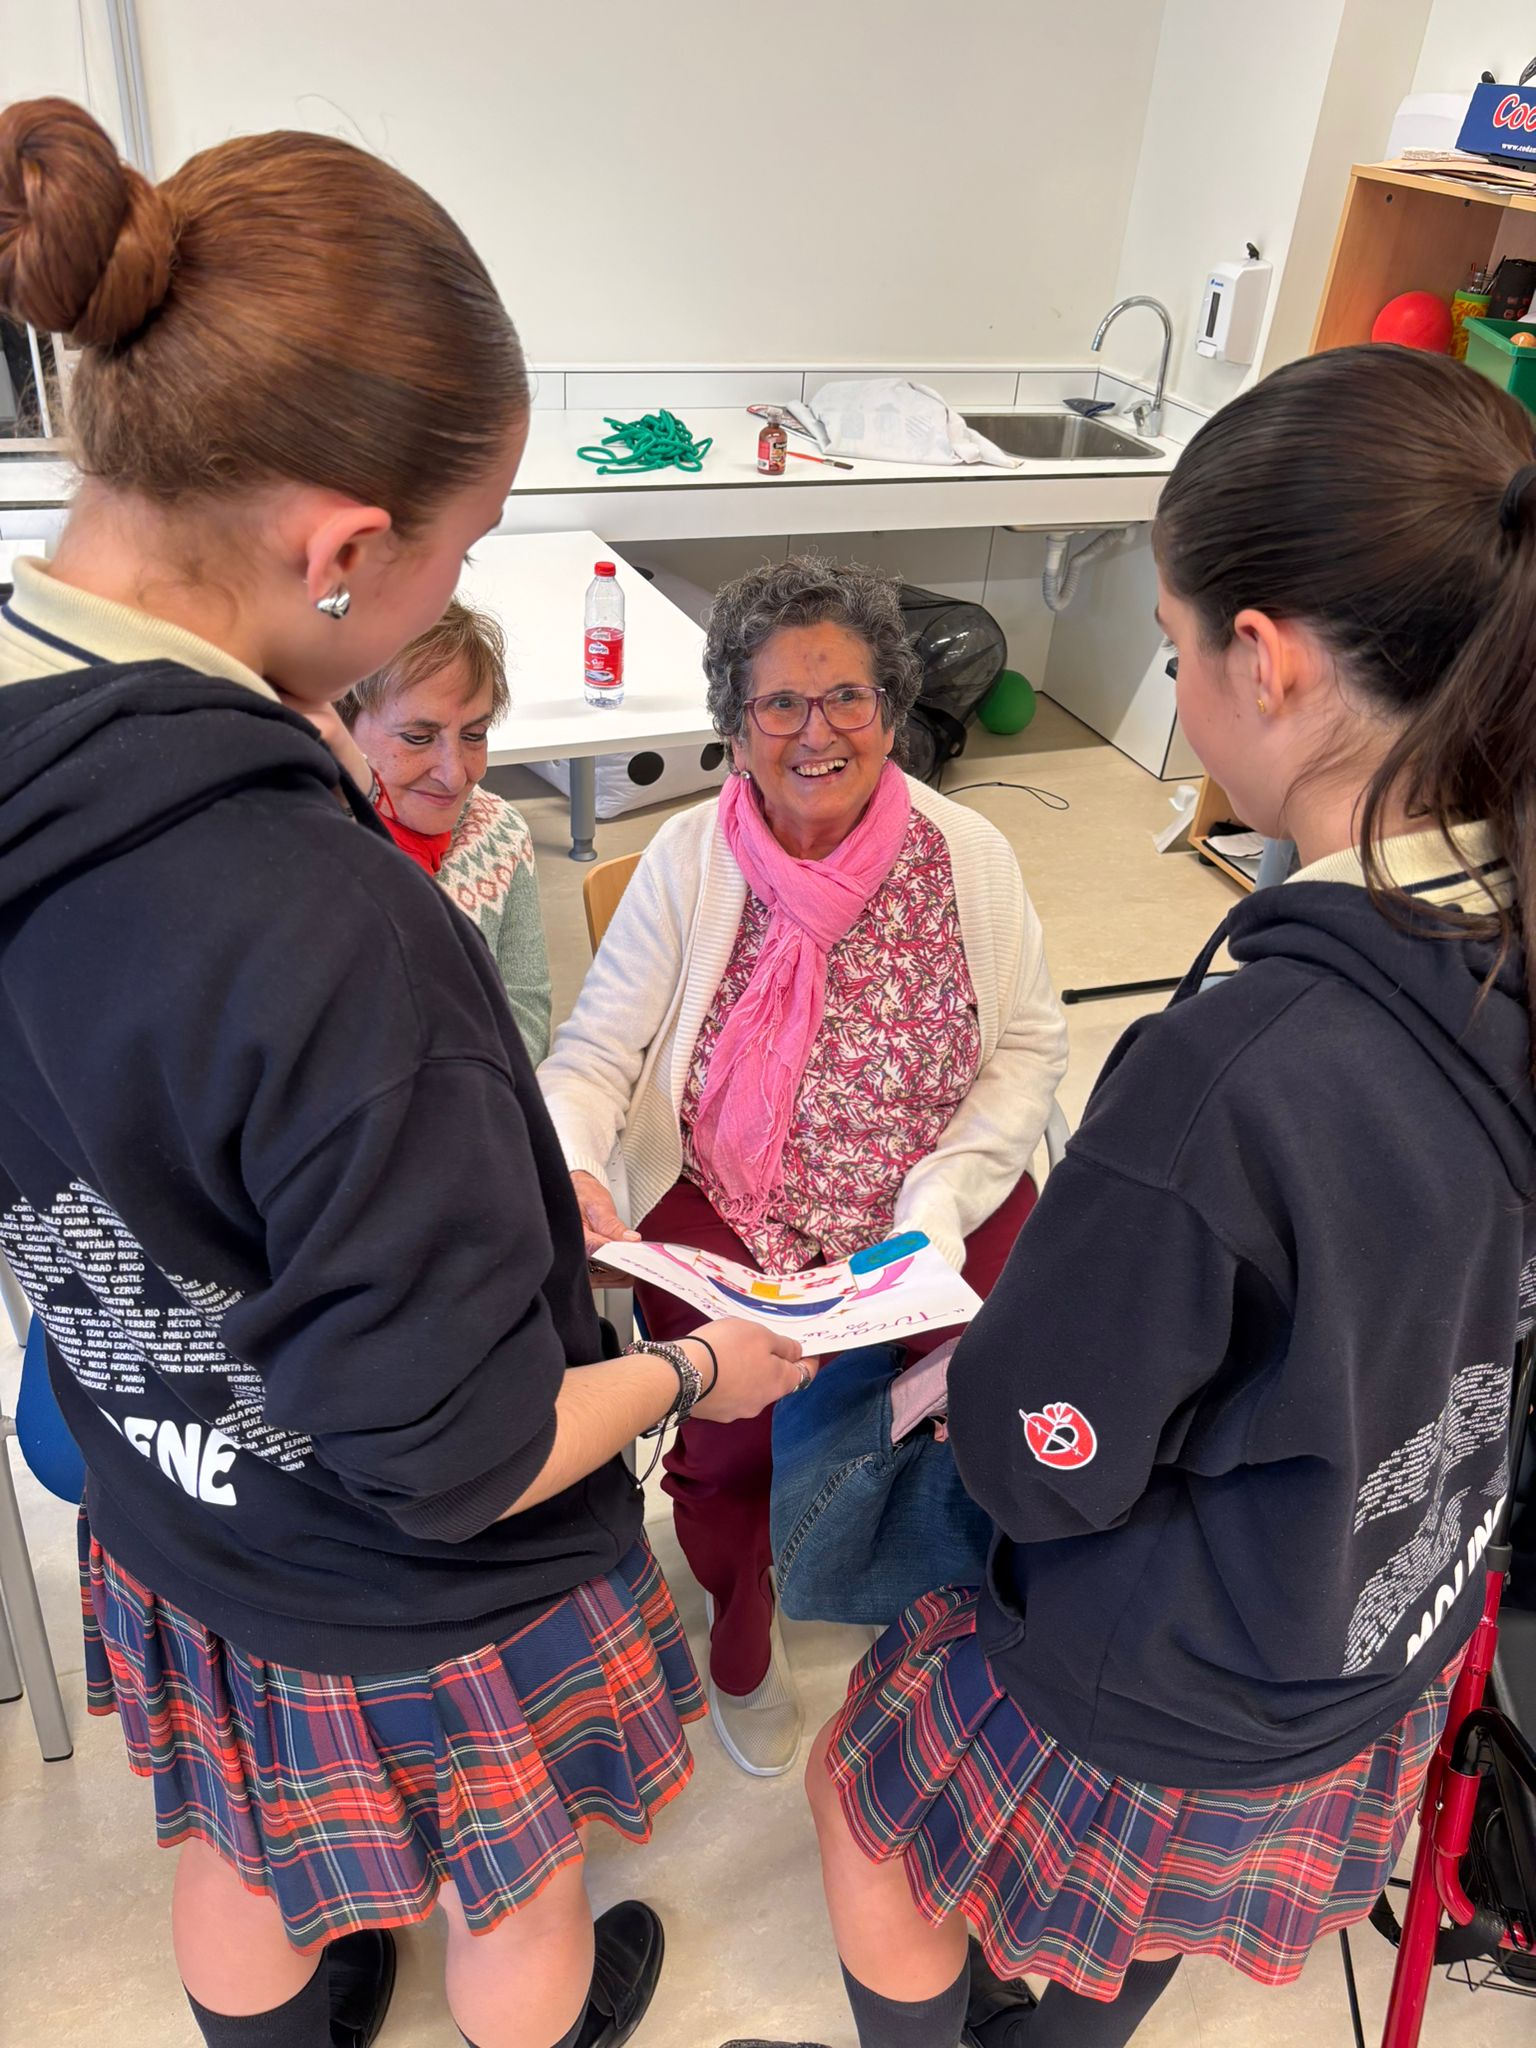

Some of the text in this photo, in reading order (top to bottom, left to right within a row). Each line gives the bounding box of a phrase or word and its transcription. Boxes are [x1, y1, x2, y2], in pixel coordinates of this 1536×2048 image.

[56, 1193, 73, 1202] RIO
[51, 1204, 89, 1214] HÉCTOR
[21, 1213, 35, 1222] RIO
[62, 1228, 103, 1238] ONRUBIA
[75, 1238, 116, 1250] NATÀLIA
[117, 1251, 139, 1260] RUIZ
[87, 1263, 112, 1272] ABAD
[119, 1262, 145, 1271] HUGO
[74, 1307, 93, 1317] RUIZ
[126, 1308, 143, 1318] DEL
[144, 1308, 161, 1317] RIO
[167, 1308, 198, 1317] BENJA
[80, 1318, 111, 1329] CARLOS
[166, 1318, 202, 1328] HÉCTOR
[86, 1328, 104, 1338] IZAN
[163, 1330, 192, 1340] PABLO
[188, 1341, 215, 1350] IRENE
[80, 1349, 107, 1359] GOMAR
[153, 1352, 226, 1362] CARLA POMARES
[88, 1360, 108, 1370] NEUS
[183, 1363, 205, 1374] RUIZ
[210, 1363, 241, 1373] MARTA
[115, 1384, 145, 1394] BLANCA
[215, 1410, 245, 1426] CARLA
[241, 1415, 262, 1430] RUIZ
[265, 1431, 287, 1444] IZAN
